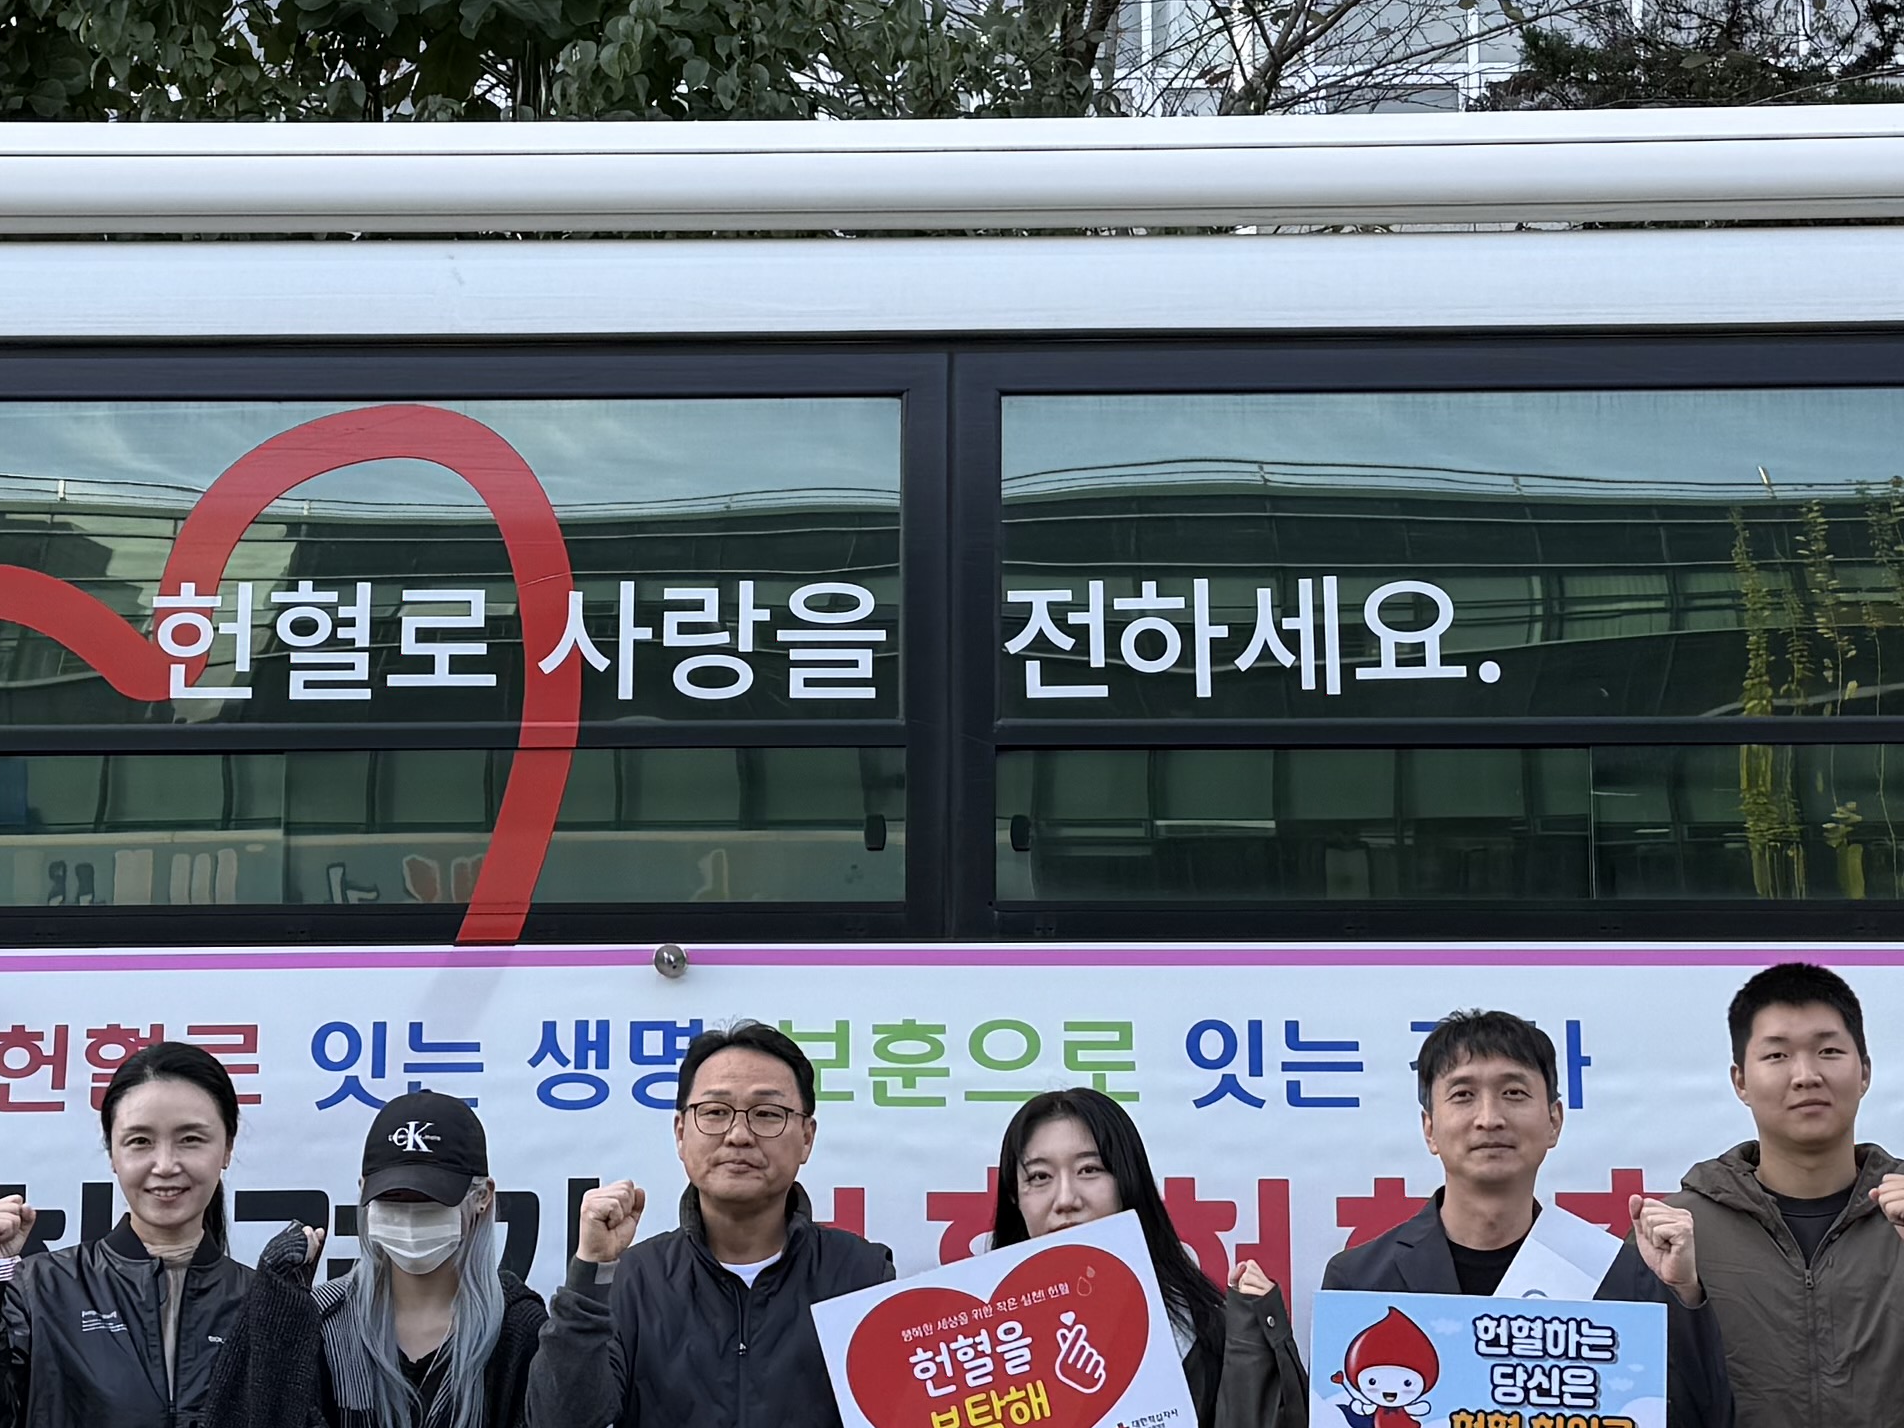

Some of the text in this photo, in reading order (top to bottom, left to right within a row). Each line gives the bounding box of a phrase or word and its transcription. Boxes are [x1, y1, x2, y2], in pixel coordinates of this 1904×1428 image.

[151, 575, 1501, 701] 헌혈로 사랑을 전하세요.
[310, 1020, 485, 1111] 잇는
[1185, 1018, 1364, 1110] 잇는
[908, 1320, 1034, 1399] 헌혈을
[1474, 1314, 1616, 1361] 헌혈하는
[1492, 1364, 1598, 1407] 당신은
